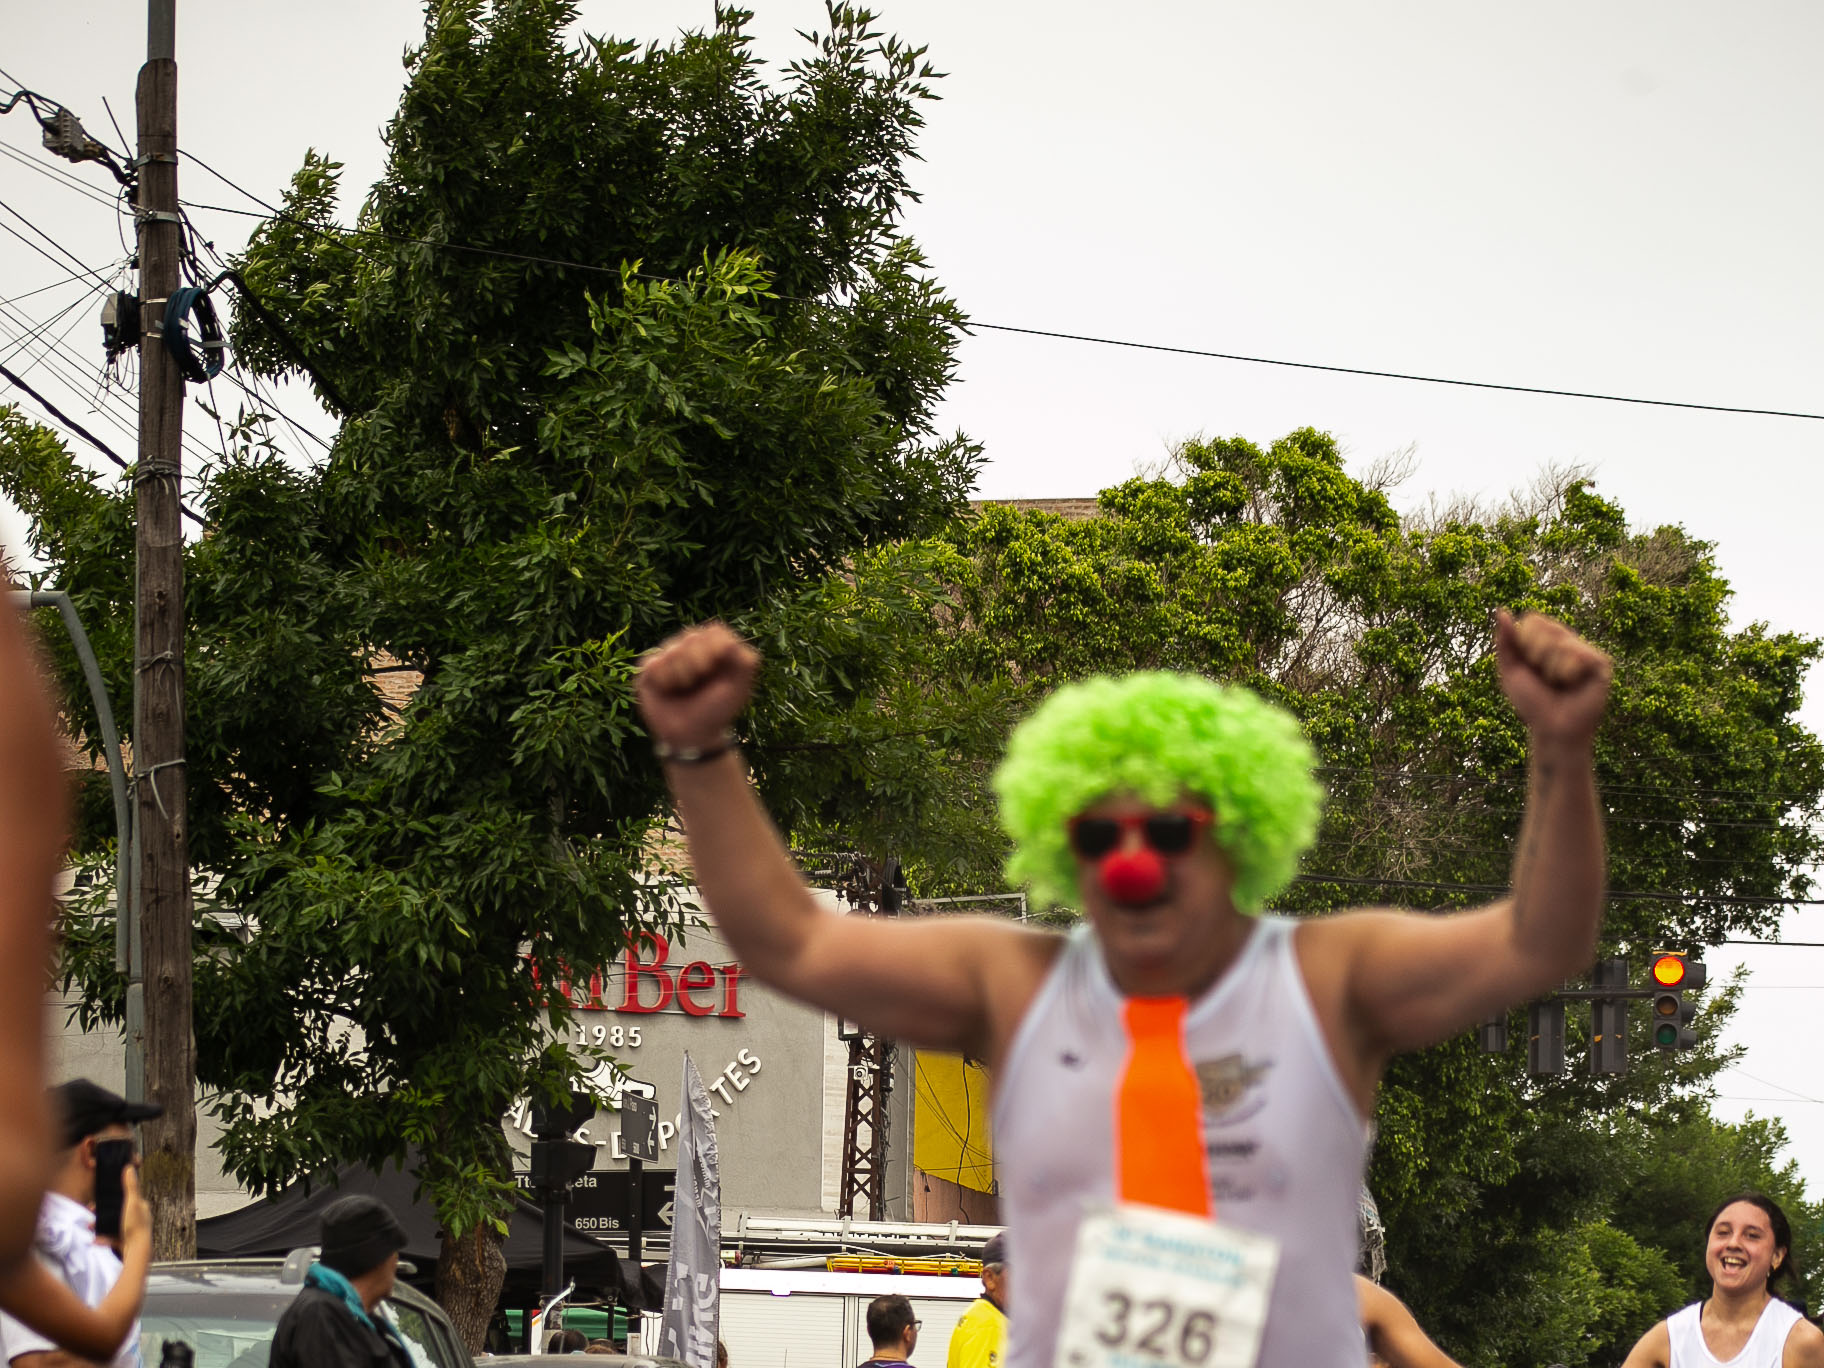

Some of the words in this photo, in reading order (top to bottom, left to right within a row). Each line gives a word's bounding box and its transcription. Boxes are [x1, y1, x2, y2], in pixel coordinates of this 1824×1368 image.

[575, 1025, 642, 1048] 1985
[575, 1218, 597, 1229] 650
[599, 1217, 620, 1229] Bis
[1093, 1288, 1218, 1364] 326
